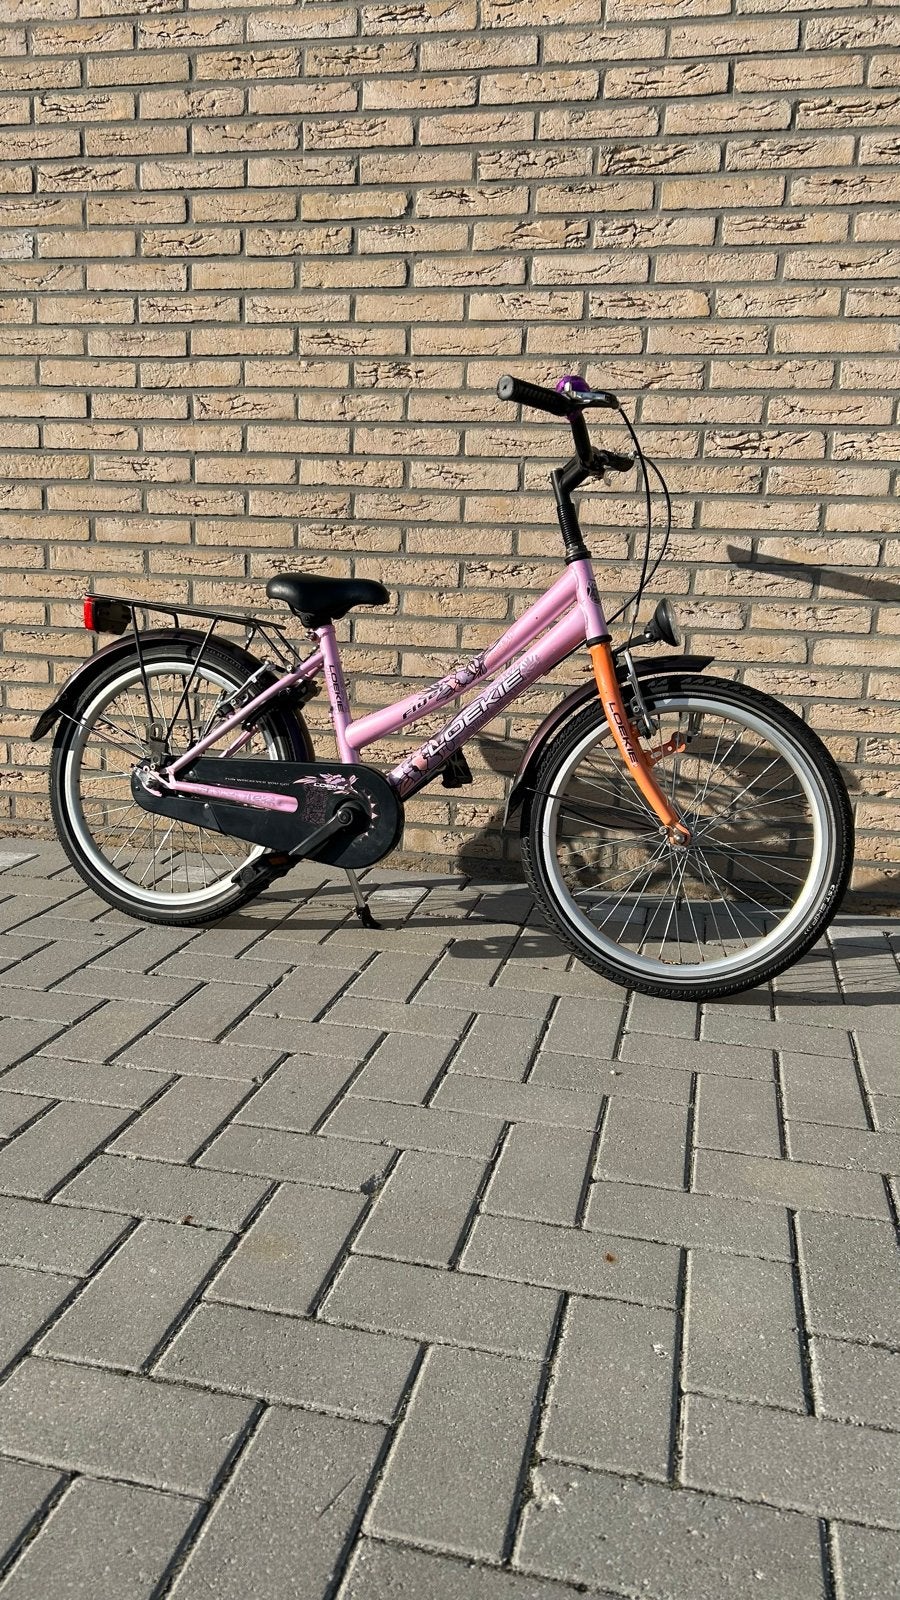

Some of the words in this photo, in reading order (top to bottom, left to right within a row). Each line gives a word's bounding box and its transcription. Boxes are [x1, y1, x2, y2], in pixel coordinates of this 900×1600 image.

[329, 664, 345, 713] LOEKIE
[428, 668, 525, 758] LOEKIE
[608, 702, 639, 763] LOEKIE
